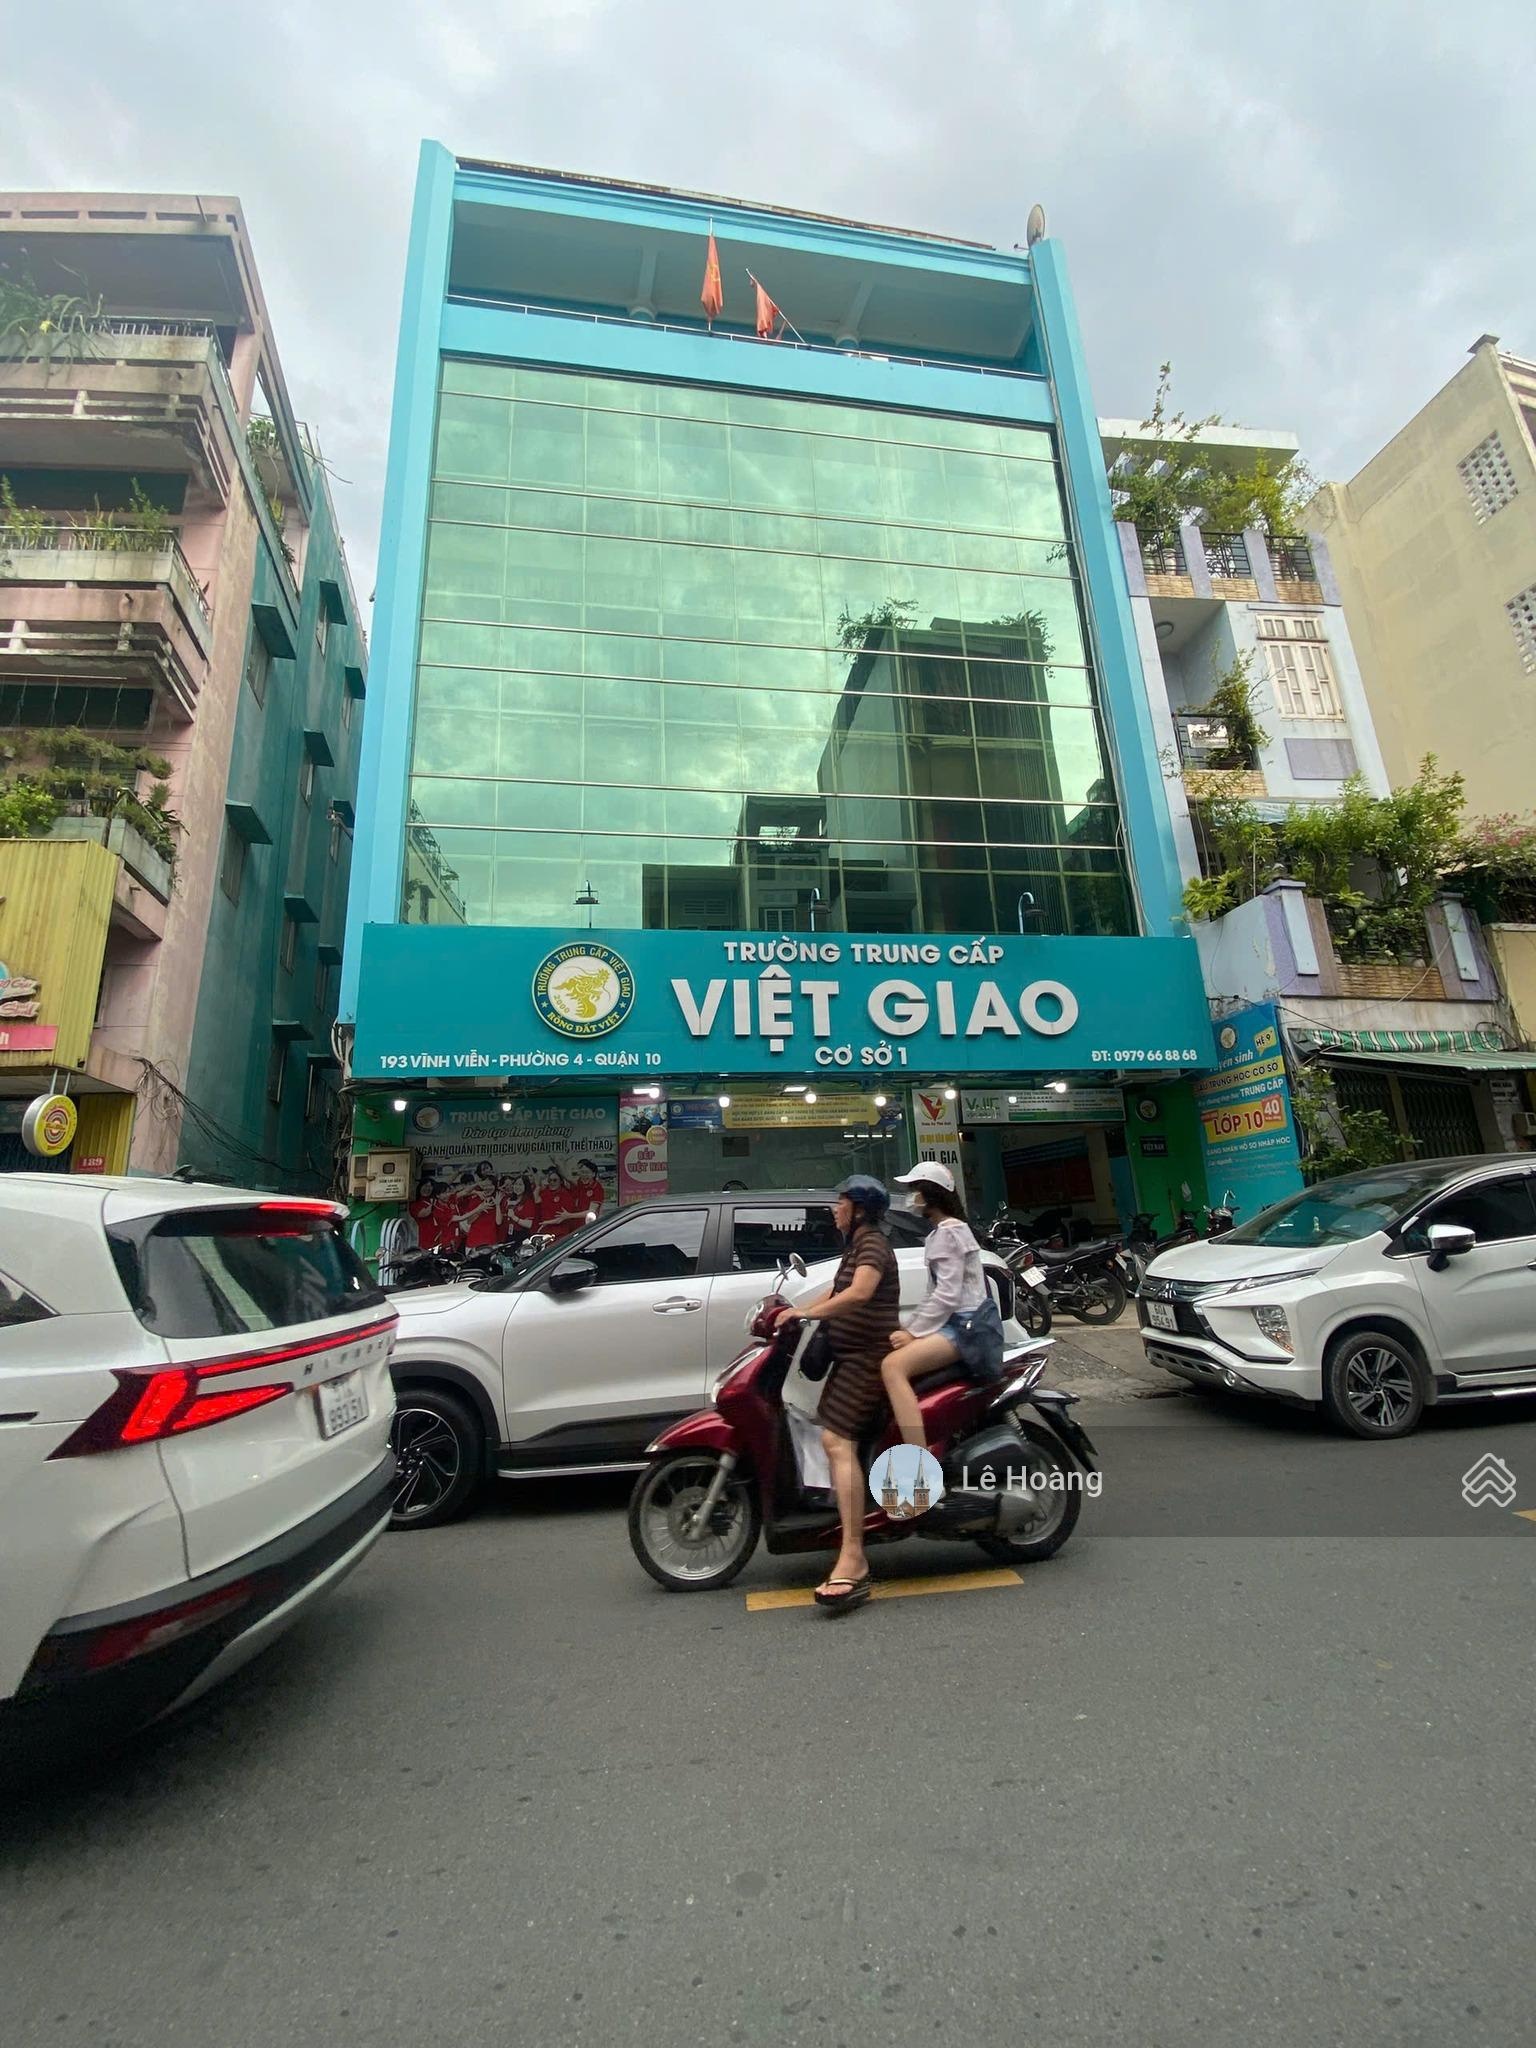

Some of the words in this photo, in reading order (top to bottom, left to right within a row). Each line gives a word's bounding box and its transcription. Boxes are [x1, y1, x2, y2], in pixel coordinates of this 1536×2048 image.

[723, 935, 841, 964] TRƯỜNG
[850, 943, 941, 964] TRUNG
[948, 935, 1004, 965] CẤP
[537, 961, 556, 997] TRƯỜNG
[554, 946, 586, 963] TRUNG
[589, 945, 609, 958] CẤP
[608, 956, 627, 975] VIỆT
[621, 976, 631, 998] GIAO
[553, 994, 571, 1014] 2000
[670, 964, 840, 1053] VIỆT
[867, 979, 1080, 1036] GIAO
[380, 1055, 408, 1069] 193
[409, 1052, 450, 1069] VĨNH
[453, 1049, 489, 1068] VIỄN
[499, 1049, 569, 1067] PHƯỜNG
[573, 1054, 583, 1066] 4
[593, 1050, 640, 1068] QUẬN
[645, 1053, 661, 1065] 10
[814, 1043, 853, 1066] CƠ
[861, 1040, 893, 1066] SỞ
[898, 1046, 908, 1065] 1
[1091, 1050, 1111, 1063] ĐT:
[1114, 1050, 1146, 1062] 0979
[1146, 1050, 1164, 1062] 66
[1164, 1050, 1181, 1062] 88
[1181, 1049, 1198, 1061] 68
[1234, 1048, 1254, 1065] sinh
[1239, 1083, 1266, 1098] TRUNG
[1266, 1078, 1284, 1091] CẤP
[449, 1110, 501, 1123] TRUNG
[501, 1106, 532, 1123] CẤP
[535, 1106, 566, 1122] VIỆT
[569, 1108, 607, 1120] GIAO
[1263, 1098, 1280, 1115] 40
[535, 1124, 574, 1139] phong
[1213, 1111, 1241, 1136] LỚP
[1243, 1110, 1264, 1130] 10
[81, 1157, 104, 1168] 189
[940, 1150, 958, 1164] GIA
